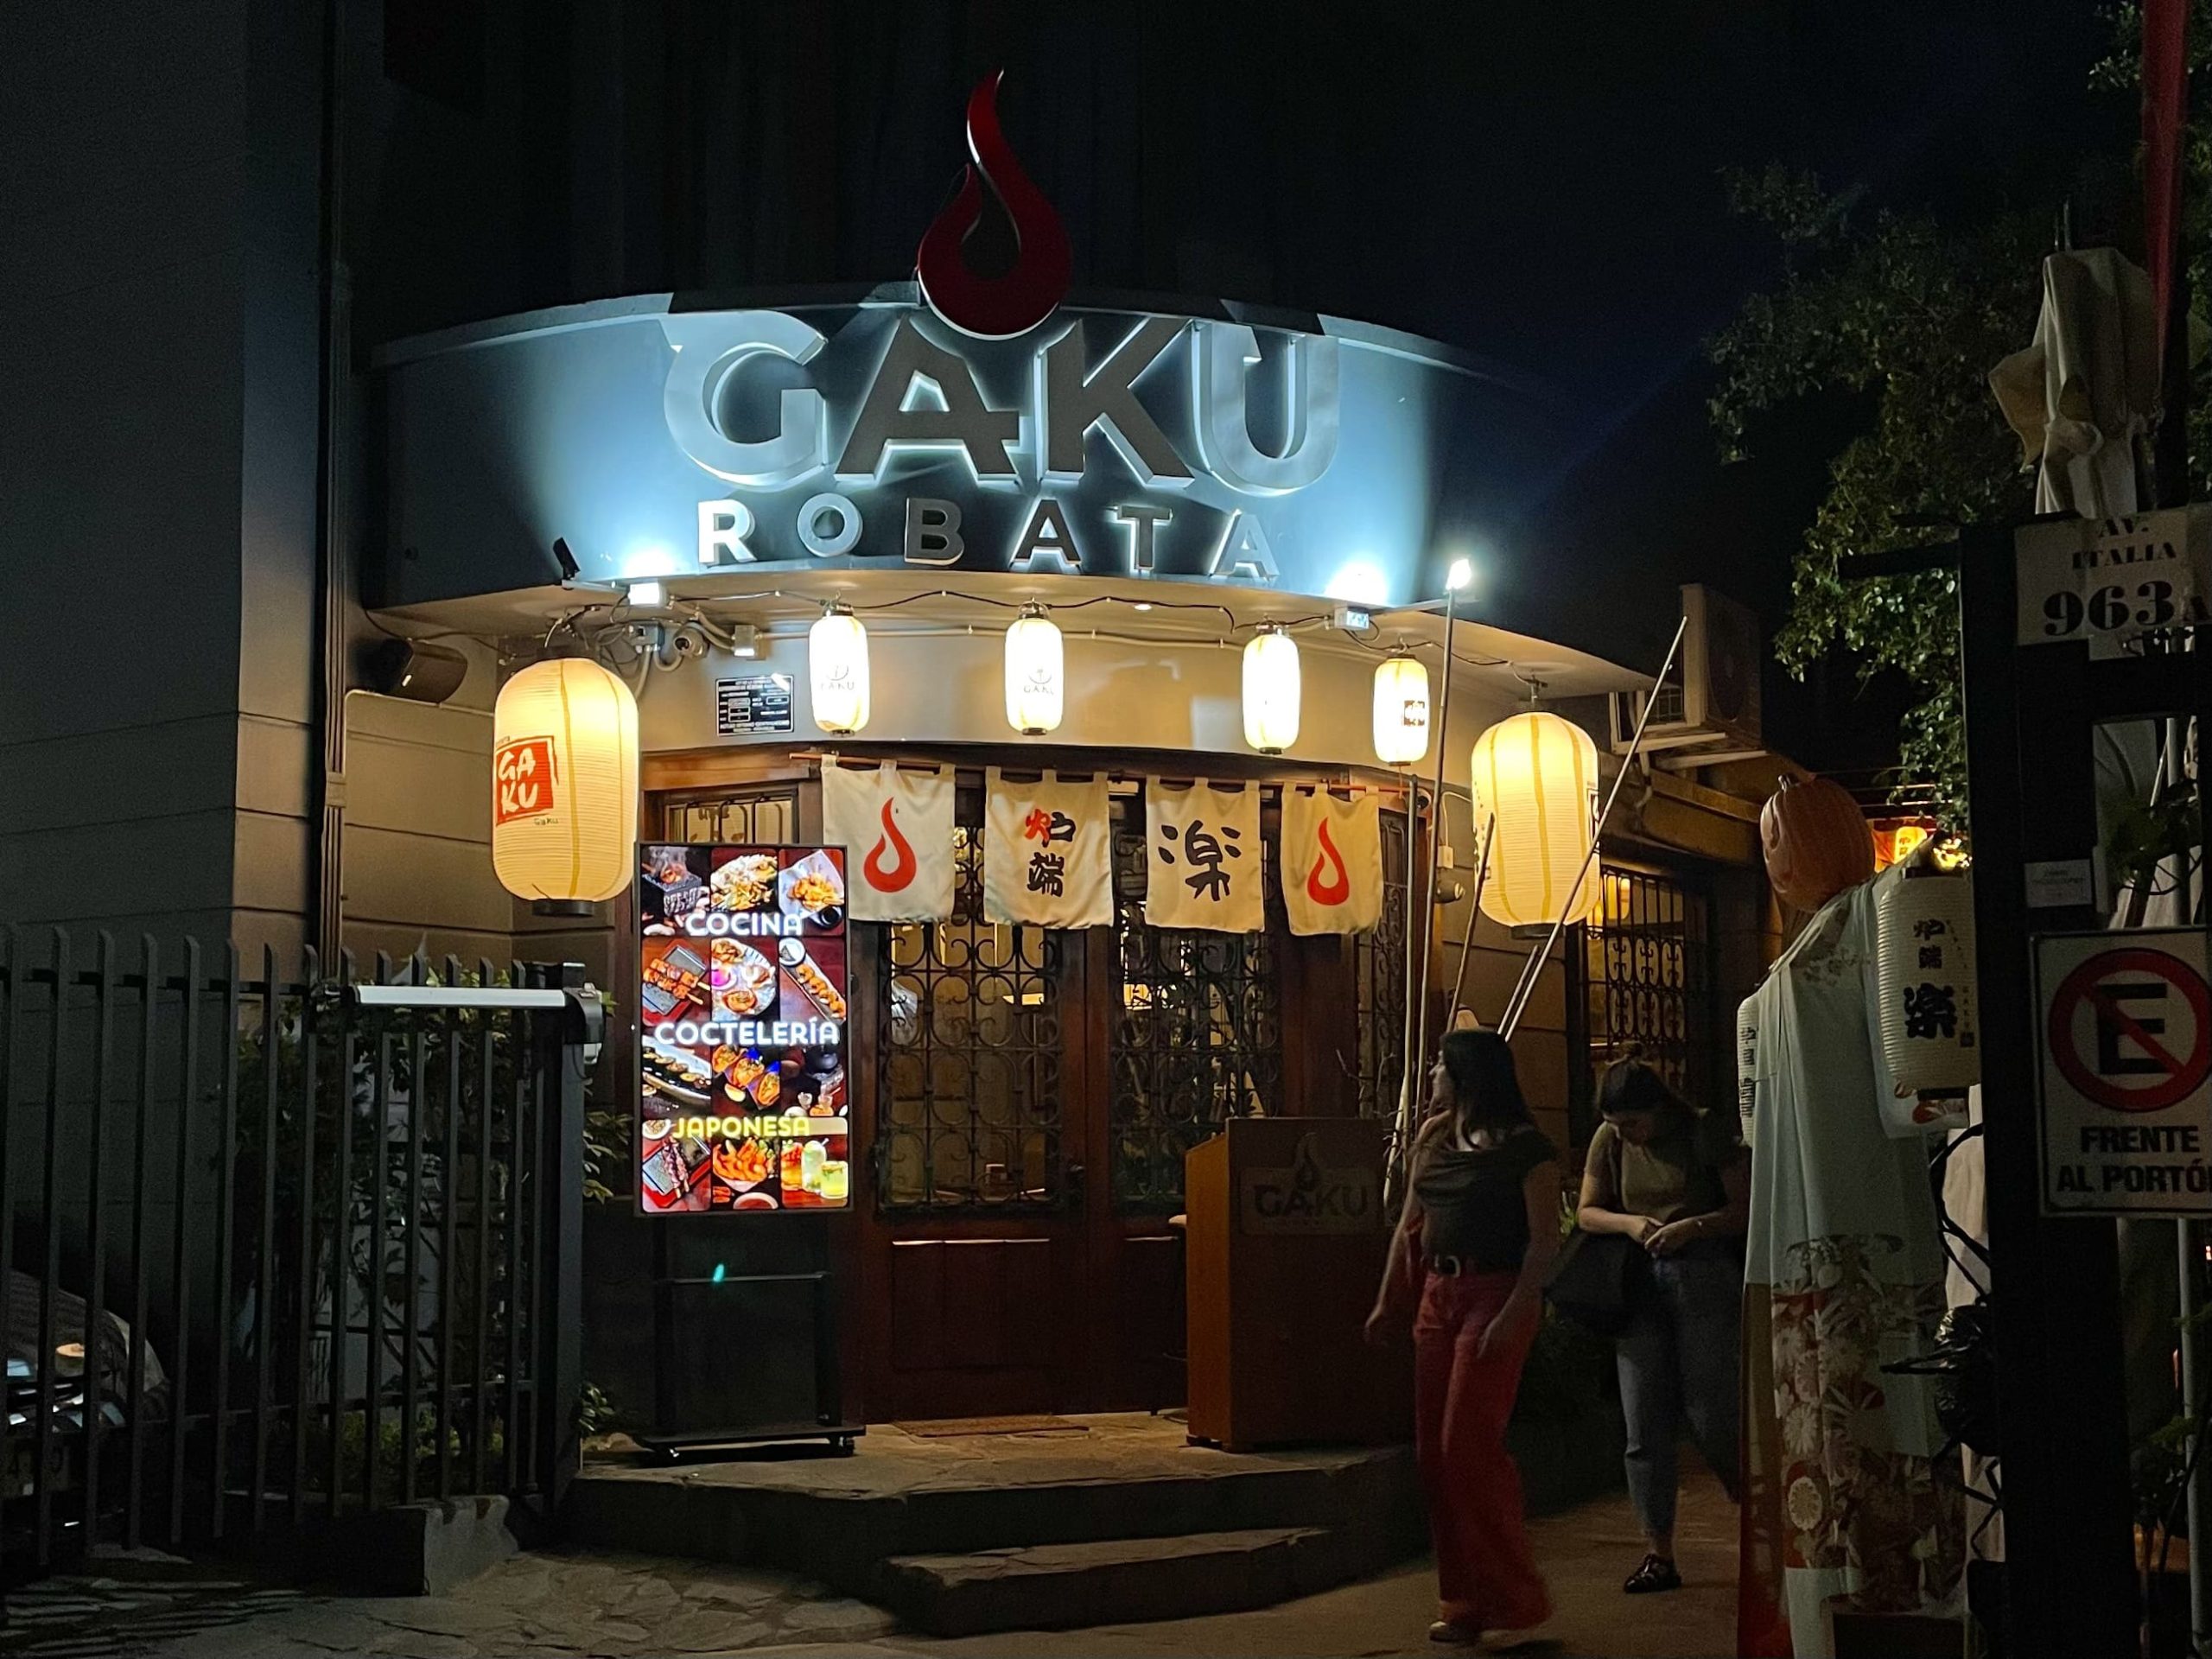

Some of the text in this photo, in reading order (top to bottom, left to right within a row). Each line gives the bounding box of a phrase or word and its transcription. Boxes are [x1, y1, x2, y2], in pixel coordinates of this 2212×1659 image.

[664, 308, 1339, 497] GAKU
[697, 493, 1280, 579] ROBATA
[2072, 543, 2176, 569] ITALIA
[2044, 581, 2175, 636] 963
[1158, 820, 1242, 901] 楽
[686, 912, 804, 937] COCINA
[654, 1016, 841, 1046] COCTELERÍA
[673, 1116, 810, 1138] JAPONESA
[2081, 1126, 2200, 1153] FRENTE
[2057, 1158, 2212, 1193] AL PORTÓ
